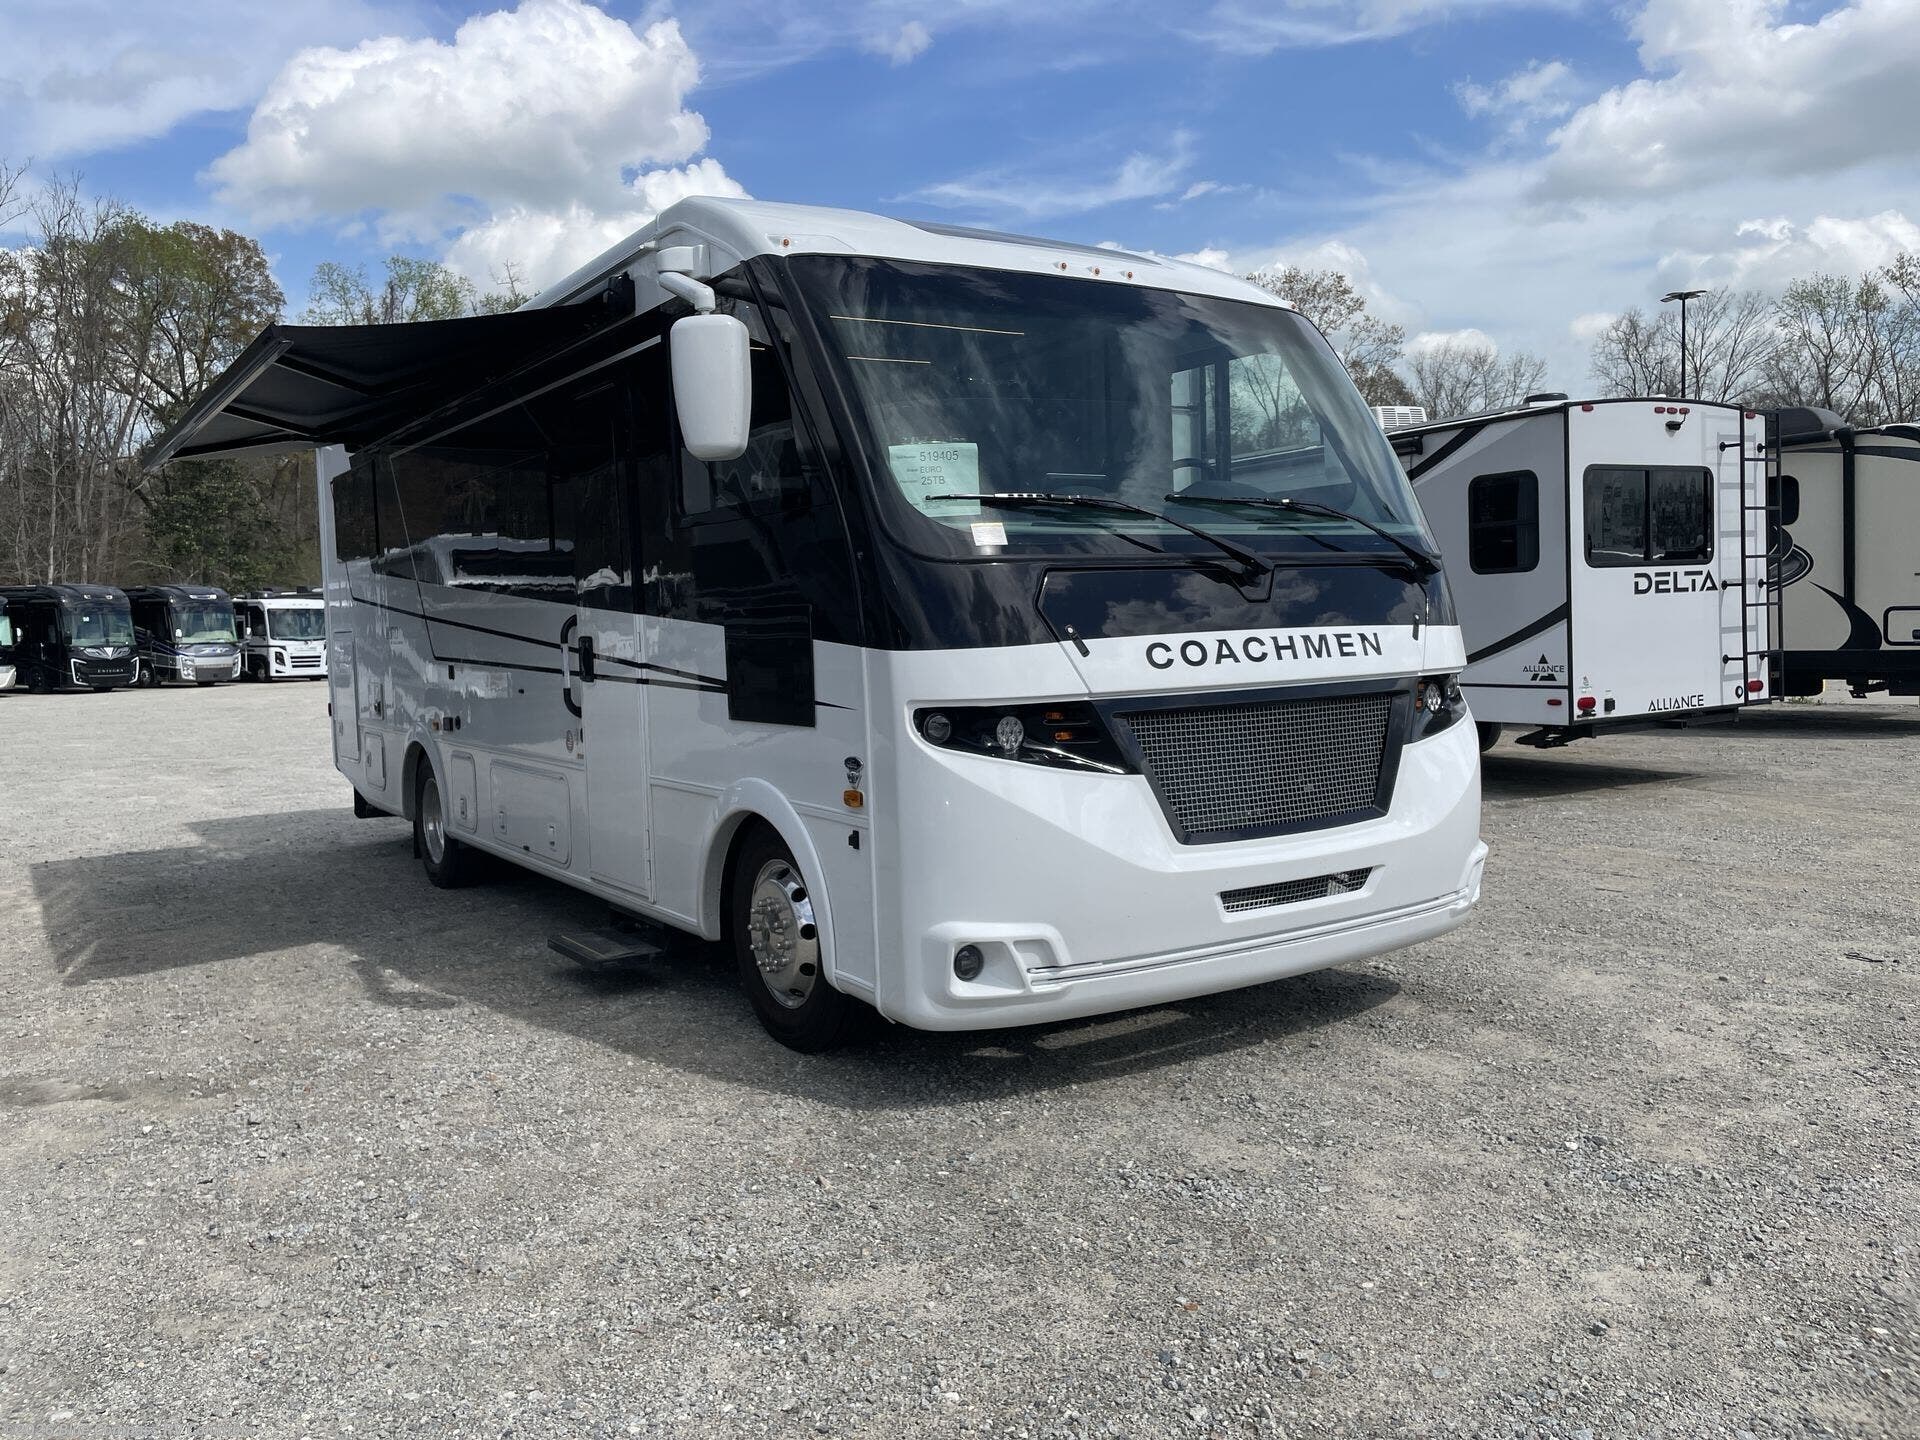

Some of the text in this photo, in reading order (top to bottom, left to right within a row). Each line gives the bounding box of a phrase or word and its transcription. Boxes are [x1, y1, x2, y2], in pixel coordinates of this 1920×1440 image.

[920, 450, 959, 461] 519405
[921, 475, 945, 485] 25TB
[1634, 569, 1719, 595] DELTA
[1145, 631, 1383, 670] COACHMEN
[1522, 664, 1565, 673] ALLIANCE
[1648, 694, 1705, 712] ALLIANCE
